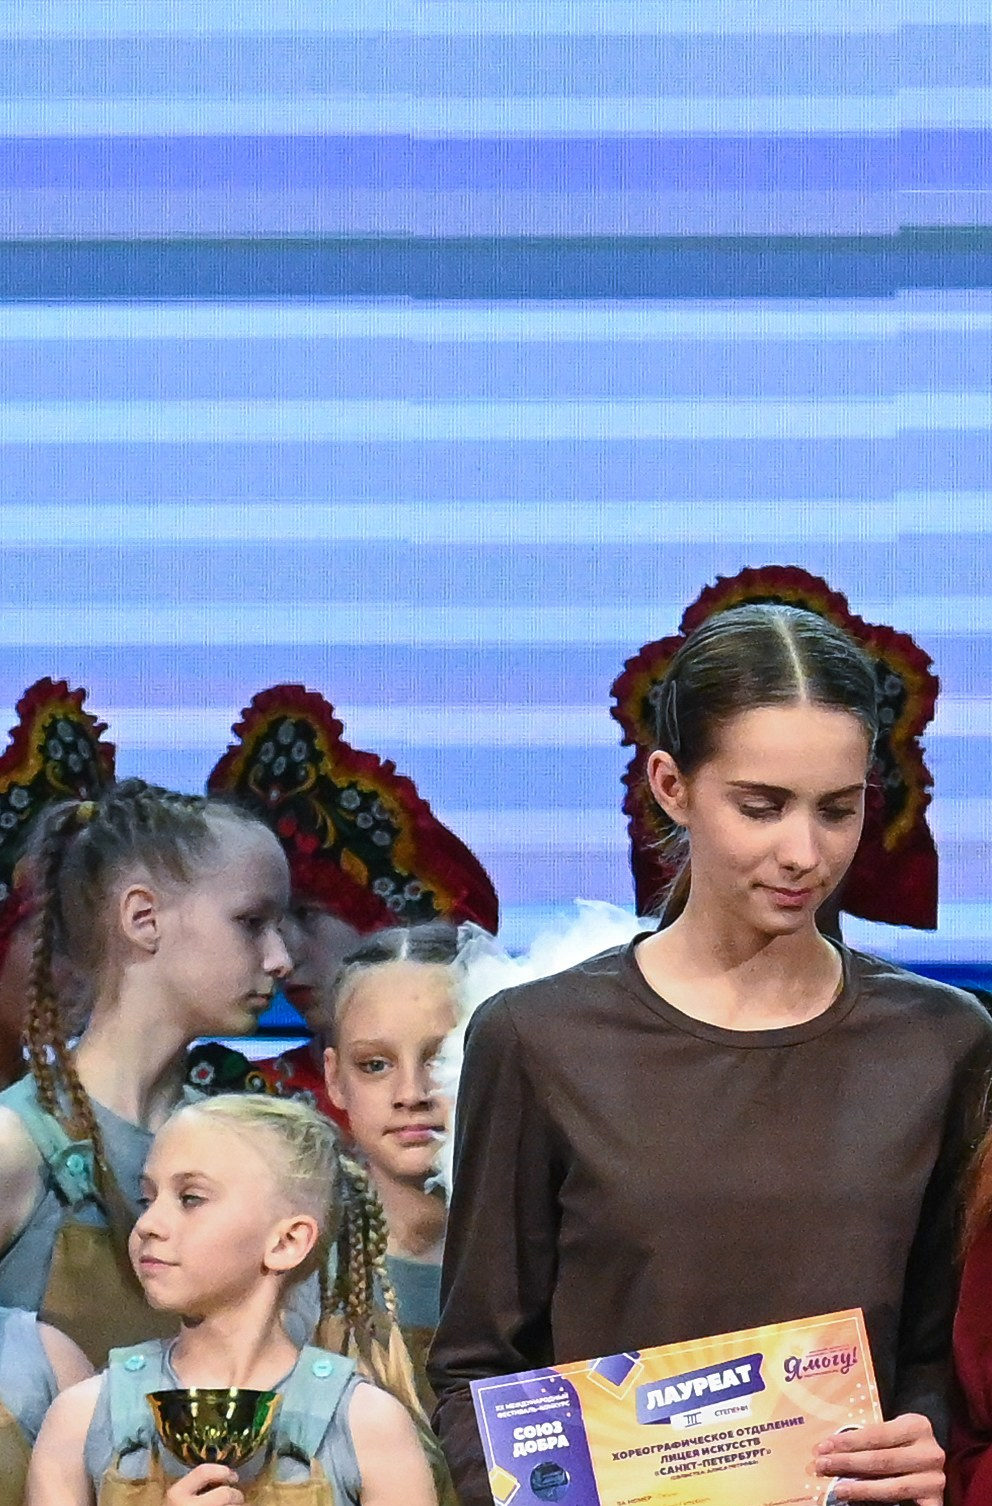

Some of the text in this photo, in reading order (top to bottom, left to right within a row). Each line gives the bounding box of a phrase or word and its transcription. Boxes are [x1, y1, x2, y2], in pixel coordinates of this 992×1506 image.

[647, 1364, 752, 1411] ЛАУРЕАТ
[714, 1405, 748, 1417] СТЕПЕНИ
[513, 1421, 563, 1440] СОЮЗ
[611, 1416, 805, 1461] ХОРЕОГРАФИЧЕСКОЕ ОТДЕЛЕНИЕ
[513, 1434, 569, 1458] ДОБРА
[660, 1437, 761, 1464] ЛИЦЕЯ ИСКУССТВ
[654, 1448, 772, 1477] «САНКТ-ПЕТЕРБУРГ»
